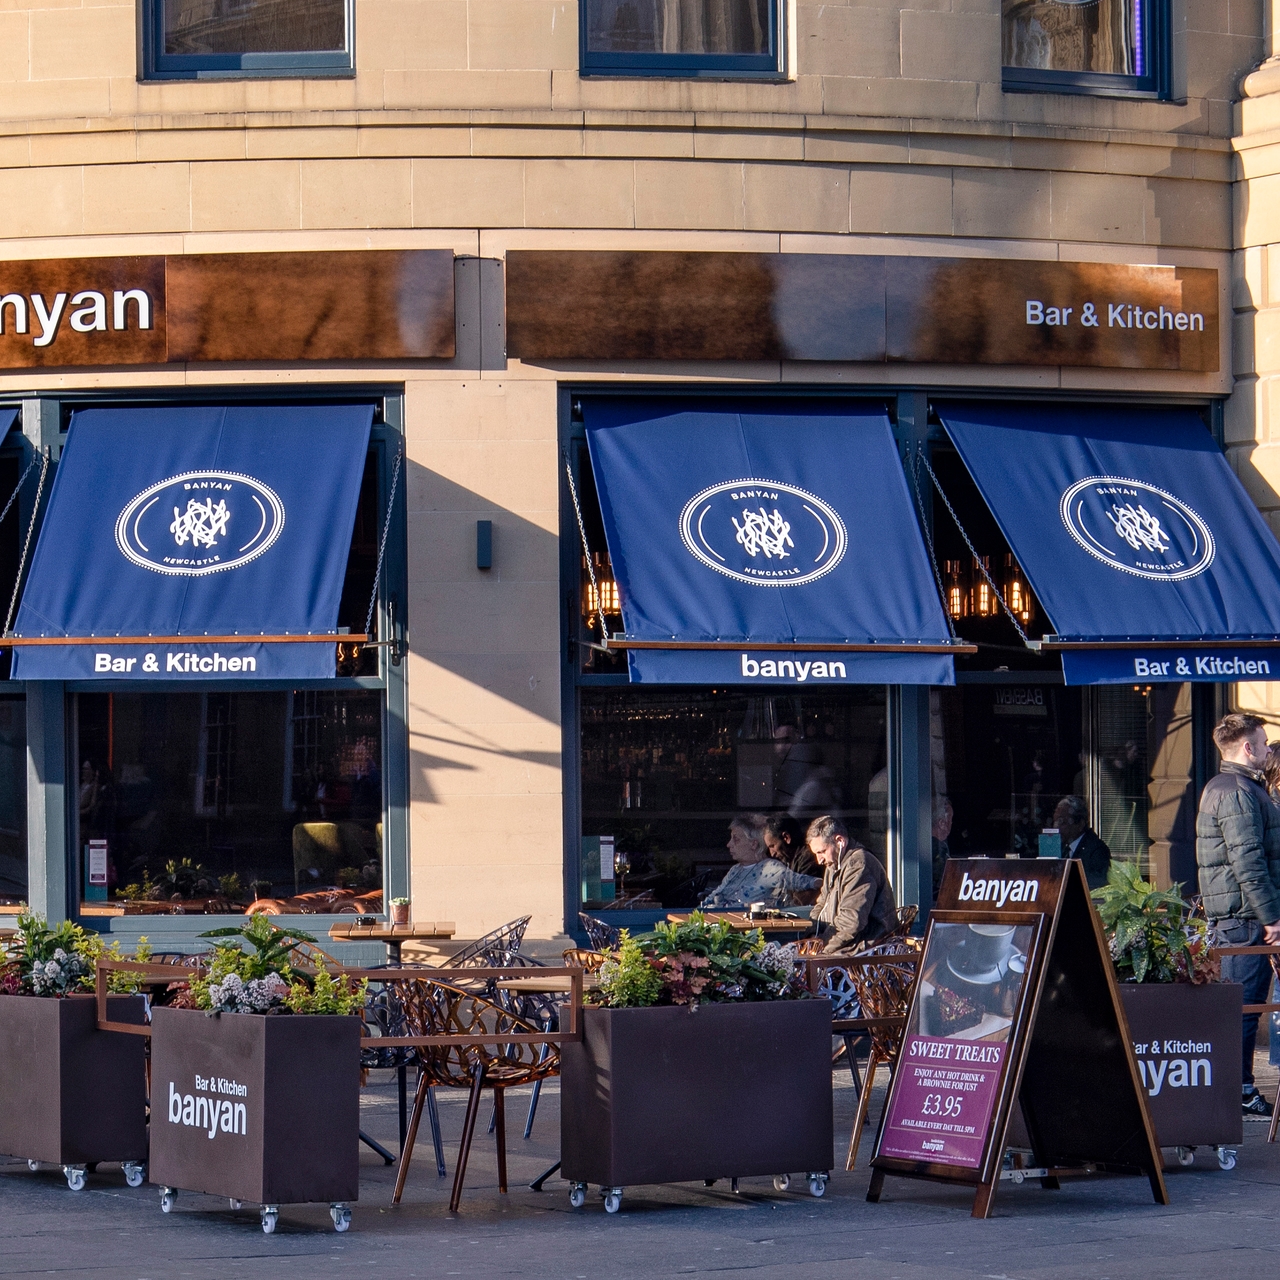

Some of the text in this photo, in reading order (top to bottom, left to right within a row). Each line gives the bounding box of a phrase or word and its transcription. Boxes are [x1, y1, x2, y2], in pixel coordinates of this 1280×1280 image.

[1026, 300, 1204, 332] Bar & Kitchen
[184, 481, 232, 491] BANYAN
[1096, 487, 1138, 497] BANYAN
[730, 490, 779, 500] BANYAN
[163, 555, 220, 566] NEWCASTLE
[1135, 560, 1185, 570] NEWCASTLE
[744, 567, 801, 577] NEWCASTLE
[95, 652, 256, 672] Bar & Kitchen
[741, 654, 847, 682] banyan
[1134, 656, 1270, 676] Bar & Kitchen
[958, 872, 1039, 908] banyan
[909, 1041, 1001, 1063] SWEET TREATS
[1133, 1040, 1212, 1054] ar & Kitchen
[914, 1068, 985, 1082] ENJOY ANY HOT DRINK &
[195, 1074, 247, 1097] Bar & Kitchen
[917, 1078, 978, 1091] A BROWNIE FOR JUST
[168, 1081, 247, 1139] banyan
[921, 1094, 963, 1117] £3.95
[901, 1119, 927, 1128] AVAILABLE
[927, 1122, 943, 1130] EVERY
[943, 1123, 953, 1131] DAY
[922, 1141, 944, 1151] banyan
